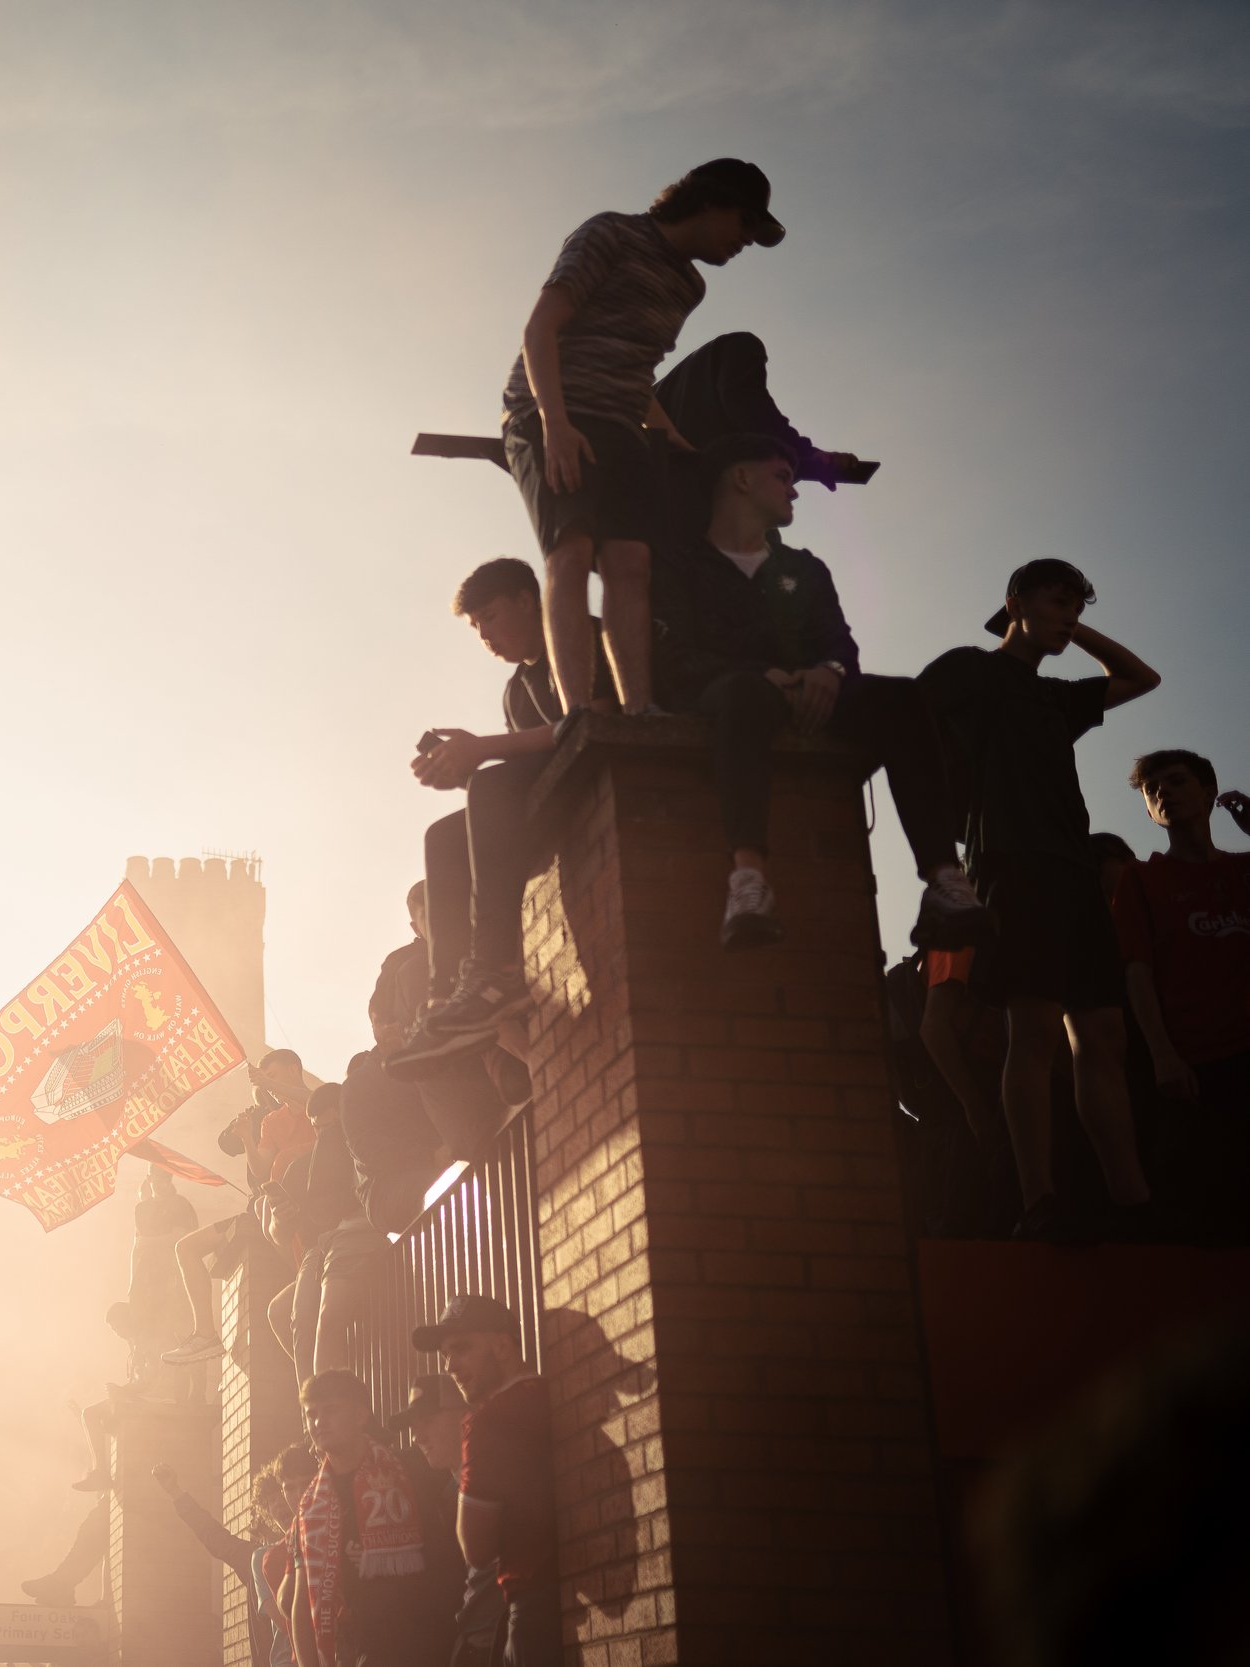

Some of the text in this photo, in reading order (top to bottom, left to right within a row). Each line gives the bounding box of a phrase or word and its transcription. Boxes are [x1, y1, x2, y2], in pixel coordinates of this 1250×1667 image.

[361, 1488, 411, 1528] 20
[322, 1564, 338, 1601] MOST
[11, 1610, 77, 1624] Four Oak
[318, 1607, 332, 1635] THE
